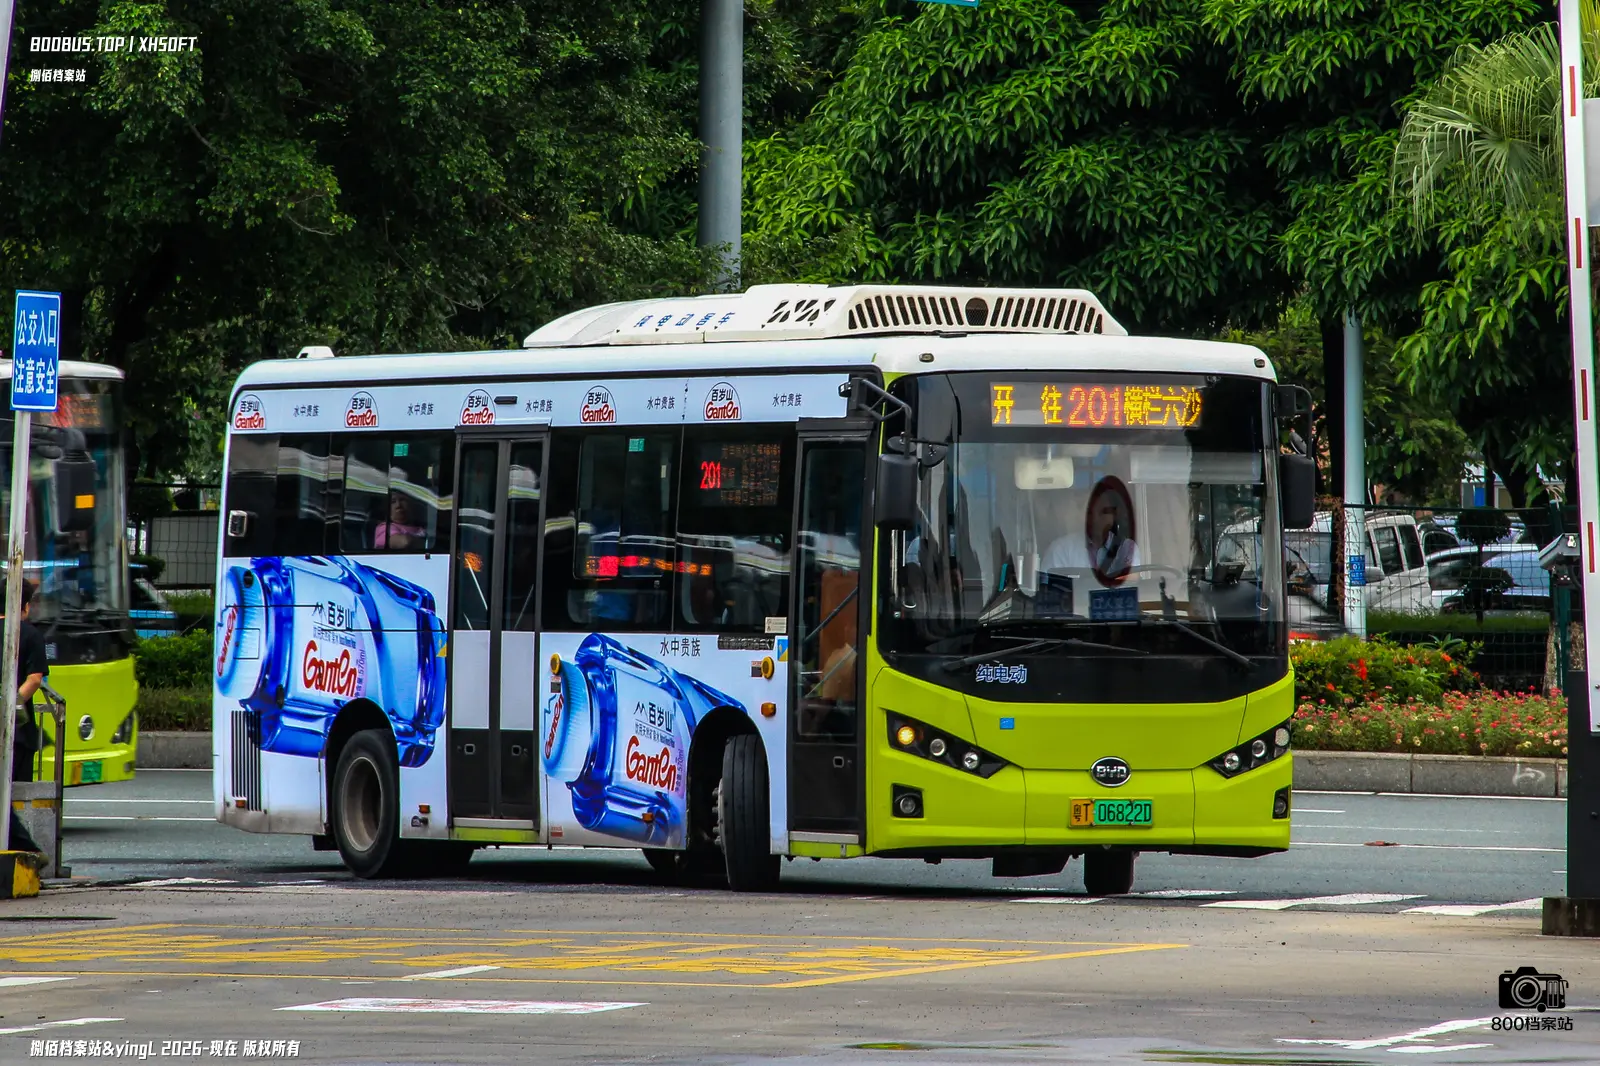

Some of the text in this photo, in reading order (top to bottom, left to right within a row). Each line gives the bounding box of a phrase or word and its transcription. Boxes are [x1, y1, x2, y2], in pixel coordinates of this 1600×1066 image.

[17, 309, 57, 347] 公交入口
[14, 357, 56, 394] 注意安全
[351, 397, 373, 411] 百岁山
[467, 395, 489, 408] 百岁山
[587, 392, 609, 405] 百岁山
[647, 396, 676, 410] 水中贵族
[711, 388, 734, 402] 百岁山
[771, 393, 803, 407] 水中贵族
[240, 400, 260, 413] 百岁山
[294, 405, 320, 418] 水中贵族
[407, 403, 434, 416] 水中贵族
[525, 400, 553, 413] 水中贵族
[581, 404, 615, 422] Ganten
[706, 401, 739, 420] Ganten
[993, 385, 1014, 424] 开
[1041, 385, 1063, 424] 往
[1068, 385, 1122, 426] 201
[234, 412, 265, 429] Ganten
[346, 409, 377, 427] Ganten
[461, 407, 494, 425] Ganten
[700, 461, 721, 489] 201
[659, 637, 701, 657] 水中贵族
[303, 640, 358, 697] Ganten
[975, 663, 1028, 684] 纯电动
[648, 702, 673, 733] 百岁山
[626, 735, 677, 792] Ganten
